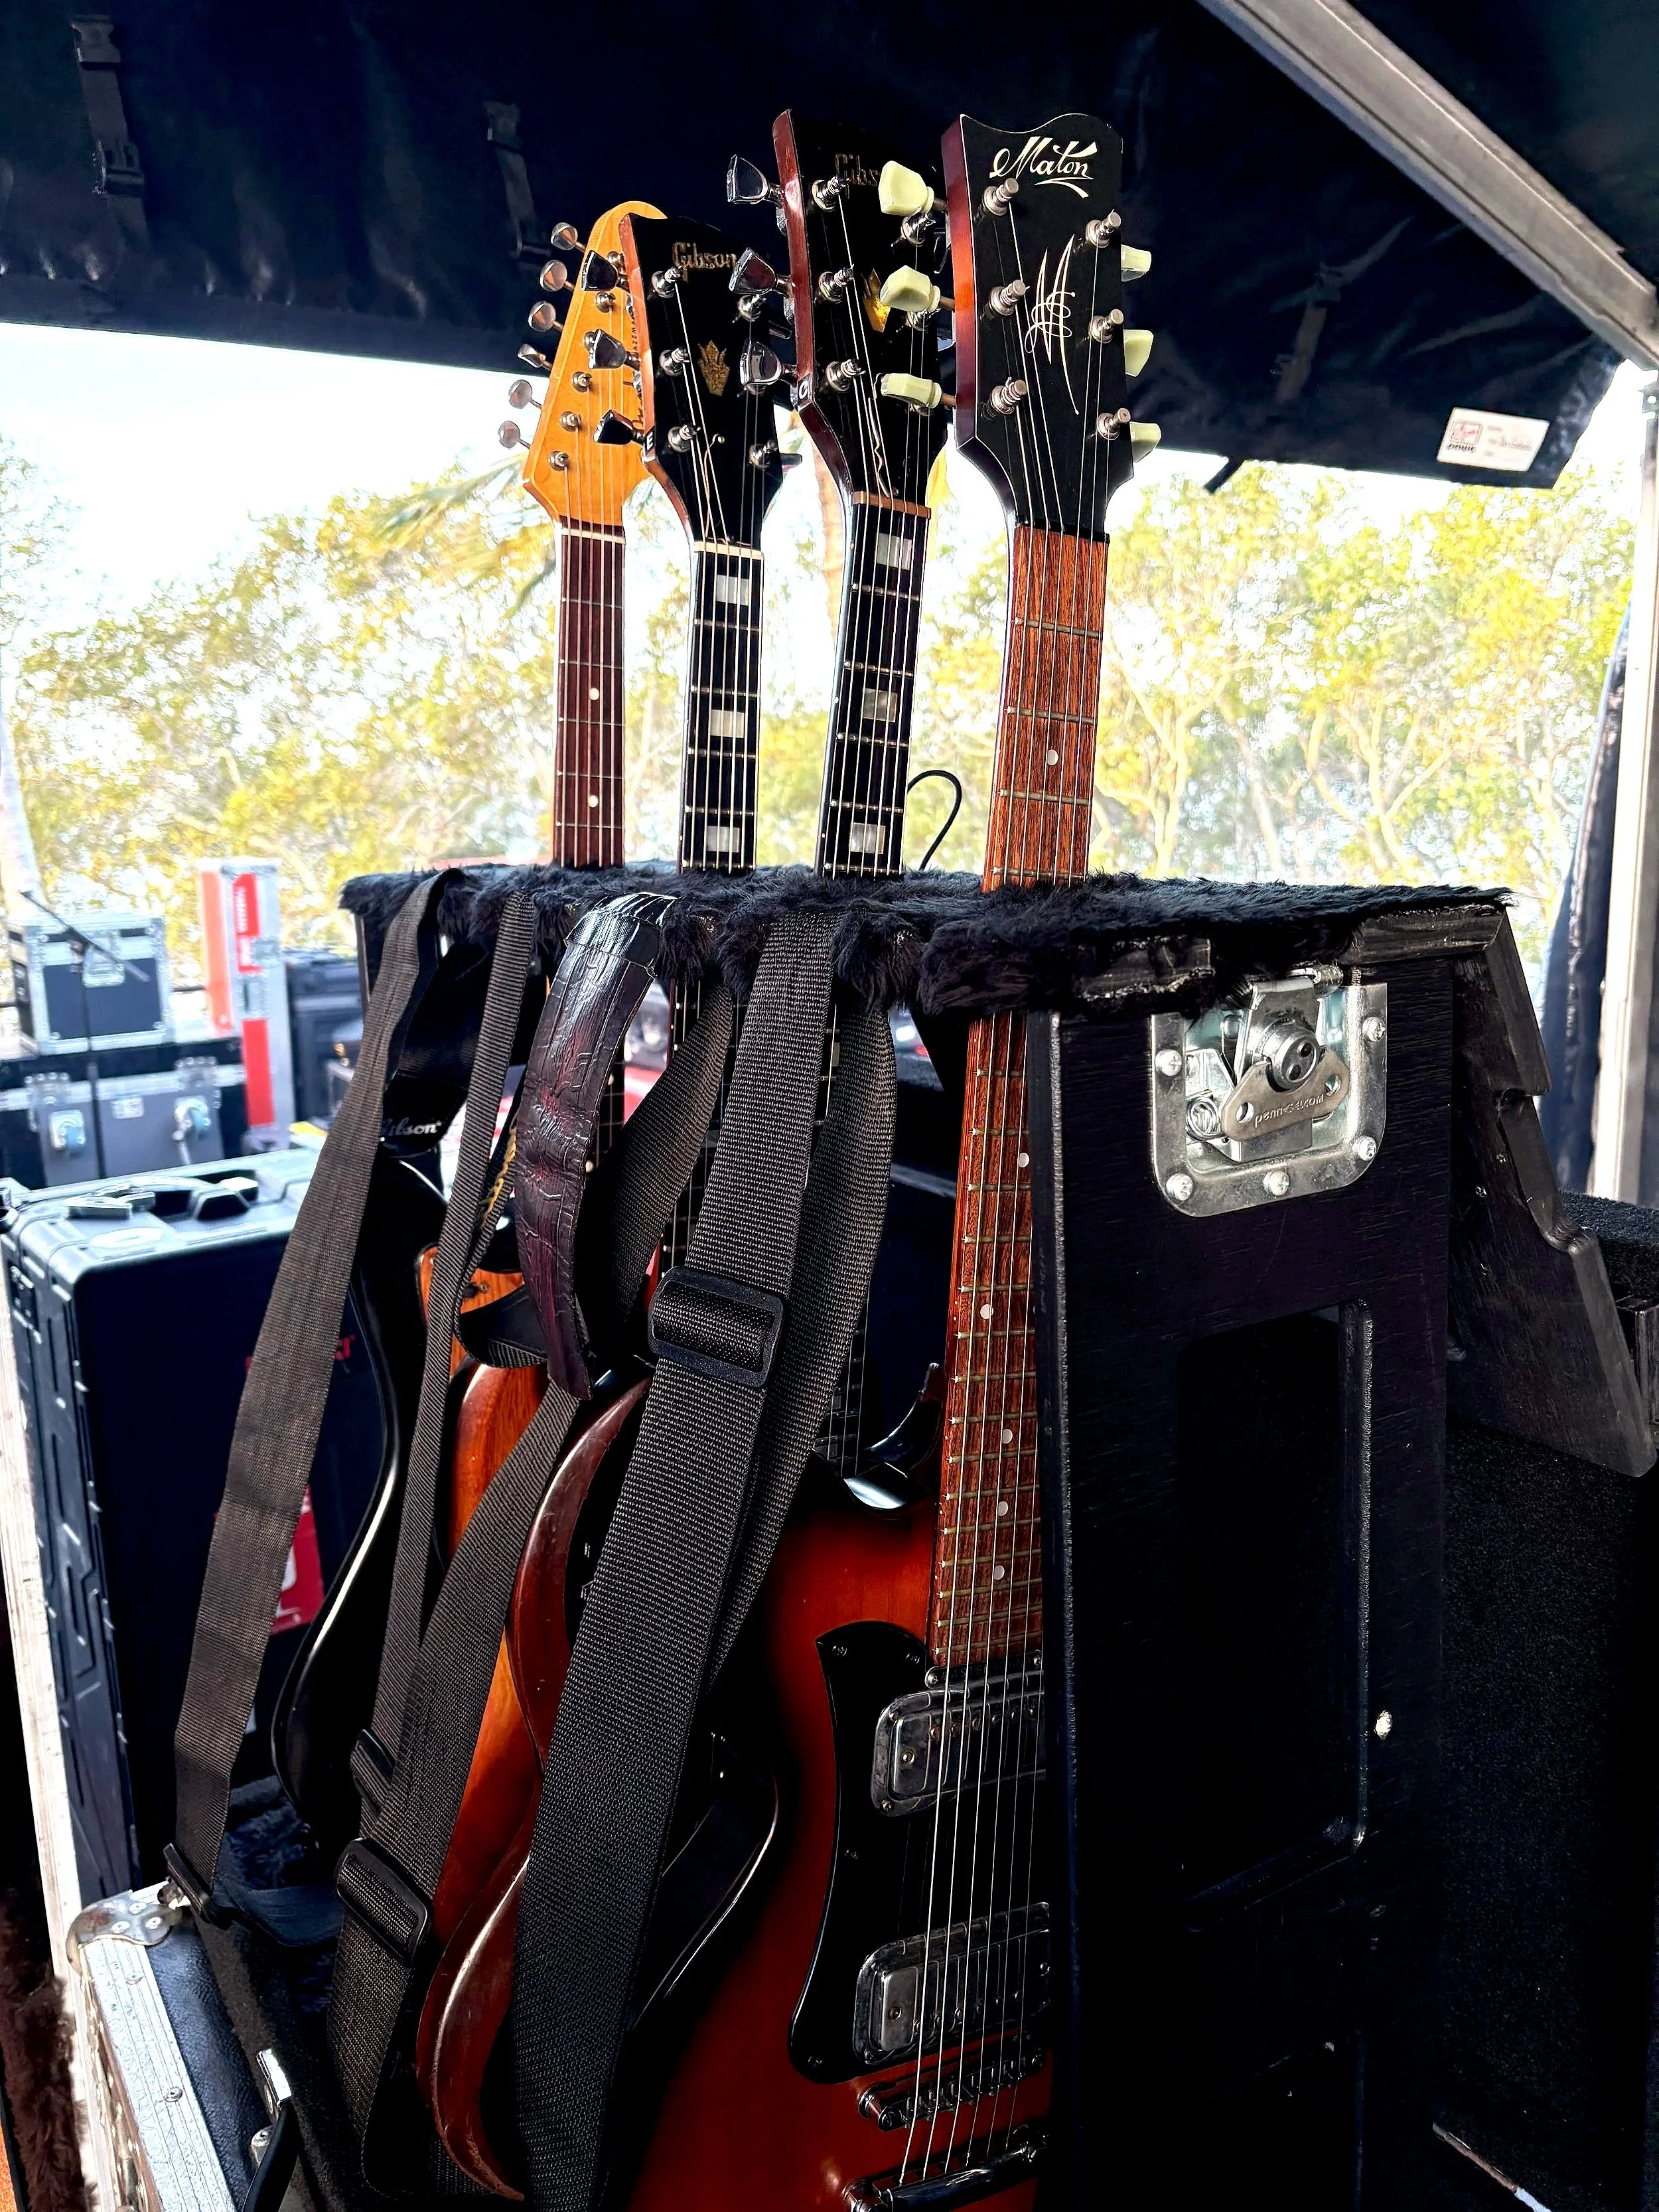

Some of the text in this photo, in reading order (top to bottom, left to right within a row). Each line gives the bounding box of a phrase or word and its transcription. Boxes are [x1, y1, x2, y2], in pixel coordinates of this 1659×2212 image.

[834, 153, 880, 199] Gibs
[989, 136, 1097, 188] Maton
[672, 241, 737, 281] Gibson
[646, 431, 654, 451] E
